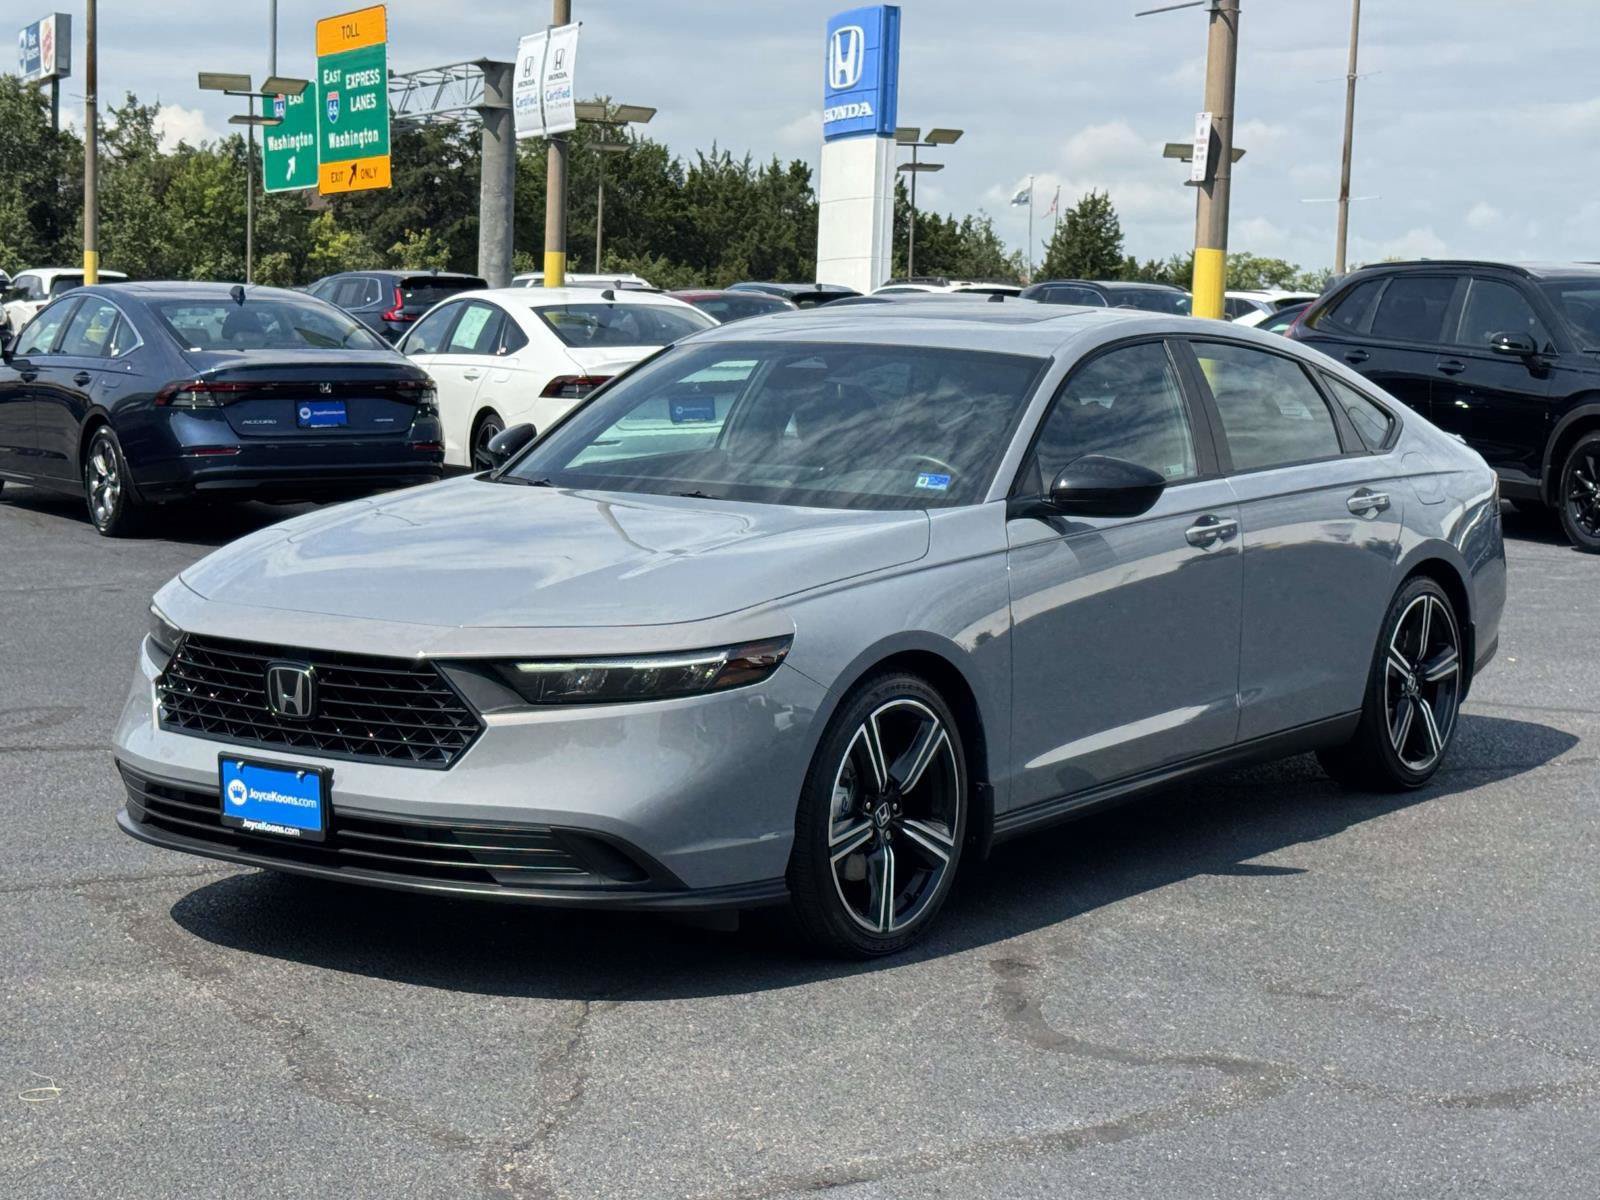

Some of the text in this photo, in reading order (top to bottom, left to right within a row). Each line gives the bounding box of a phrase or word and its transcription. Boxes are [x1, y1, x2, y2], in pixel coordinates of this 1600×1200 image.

[341, 23, 360, 40] TOLL
[323, 68, 381, 90] EAST EXPRESS
[350, 93, 377, 112] LANES
[267, 131, 314, 152] Washington
[328, 127, 379, 149] Washington
[331, 166, 378, 183] EXIT ONLY
[248, 787, 317, 809] JoyceKoons.com
[242, 818, 300, 837] JoyceKoons.com
